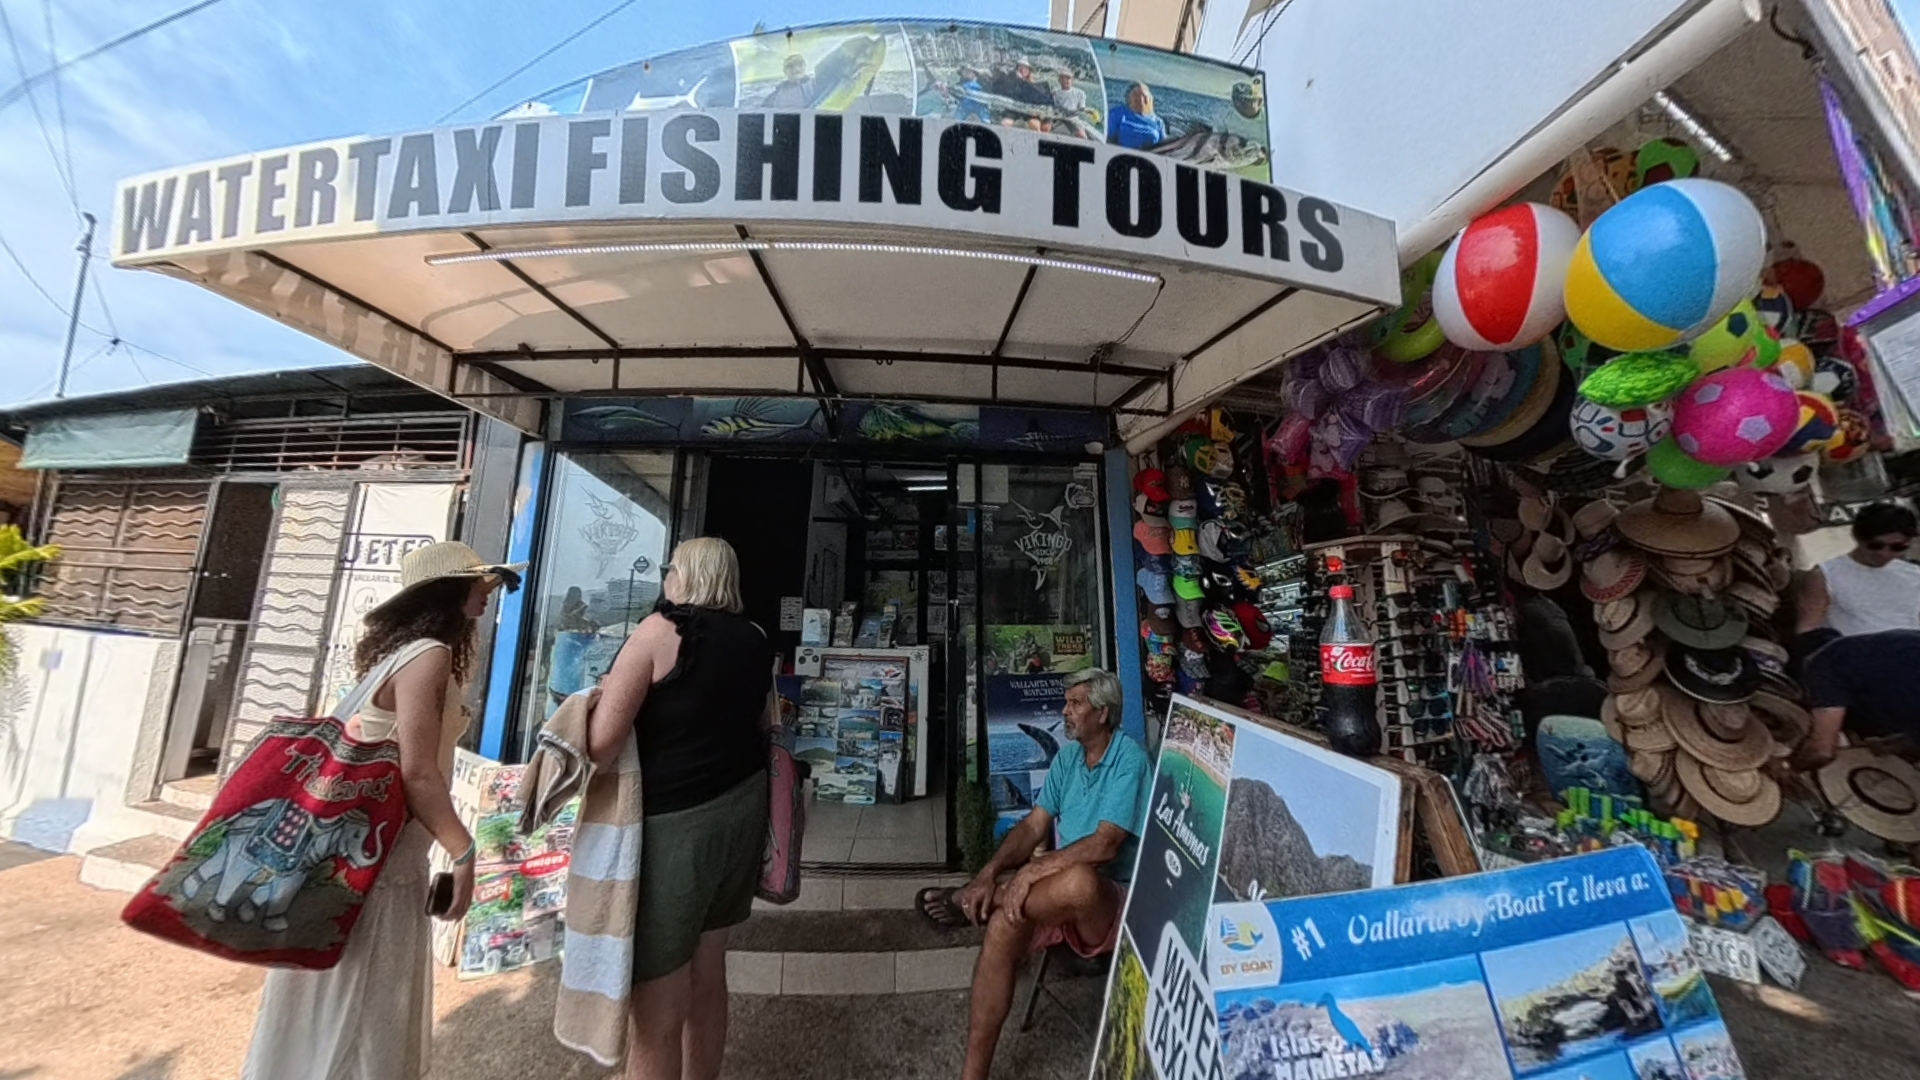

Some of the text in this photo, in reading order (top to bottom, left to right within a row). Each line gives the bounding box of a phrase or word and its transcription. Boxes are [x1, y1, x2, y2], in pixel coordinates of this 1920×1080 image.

[564, 112, 1003, 214] FISHING
[1038, 139, 1345, 273] TOURS
[1013, 532, 1073, 552] VIKINGO
[1055, 635, 1083, 643] WILD
[1009, 679, 1048, 689] VALLARTA
[280, 742, 395, 803] Thailand
[525, 855, 565, 869] UNIQUE
[1291, 917, 1327, 961] #1
[1347, 902, 1449, 945] Vallarta
[1486, 889, 1547, 921] Boat
[1547, 876, 1580, 909] Te
[1583, 874, 1628, 903] lleva
[1630, 870, 1650, 891] a:
[1220, 959, 1274, 975] BY BOAT
